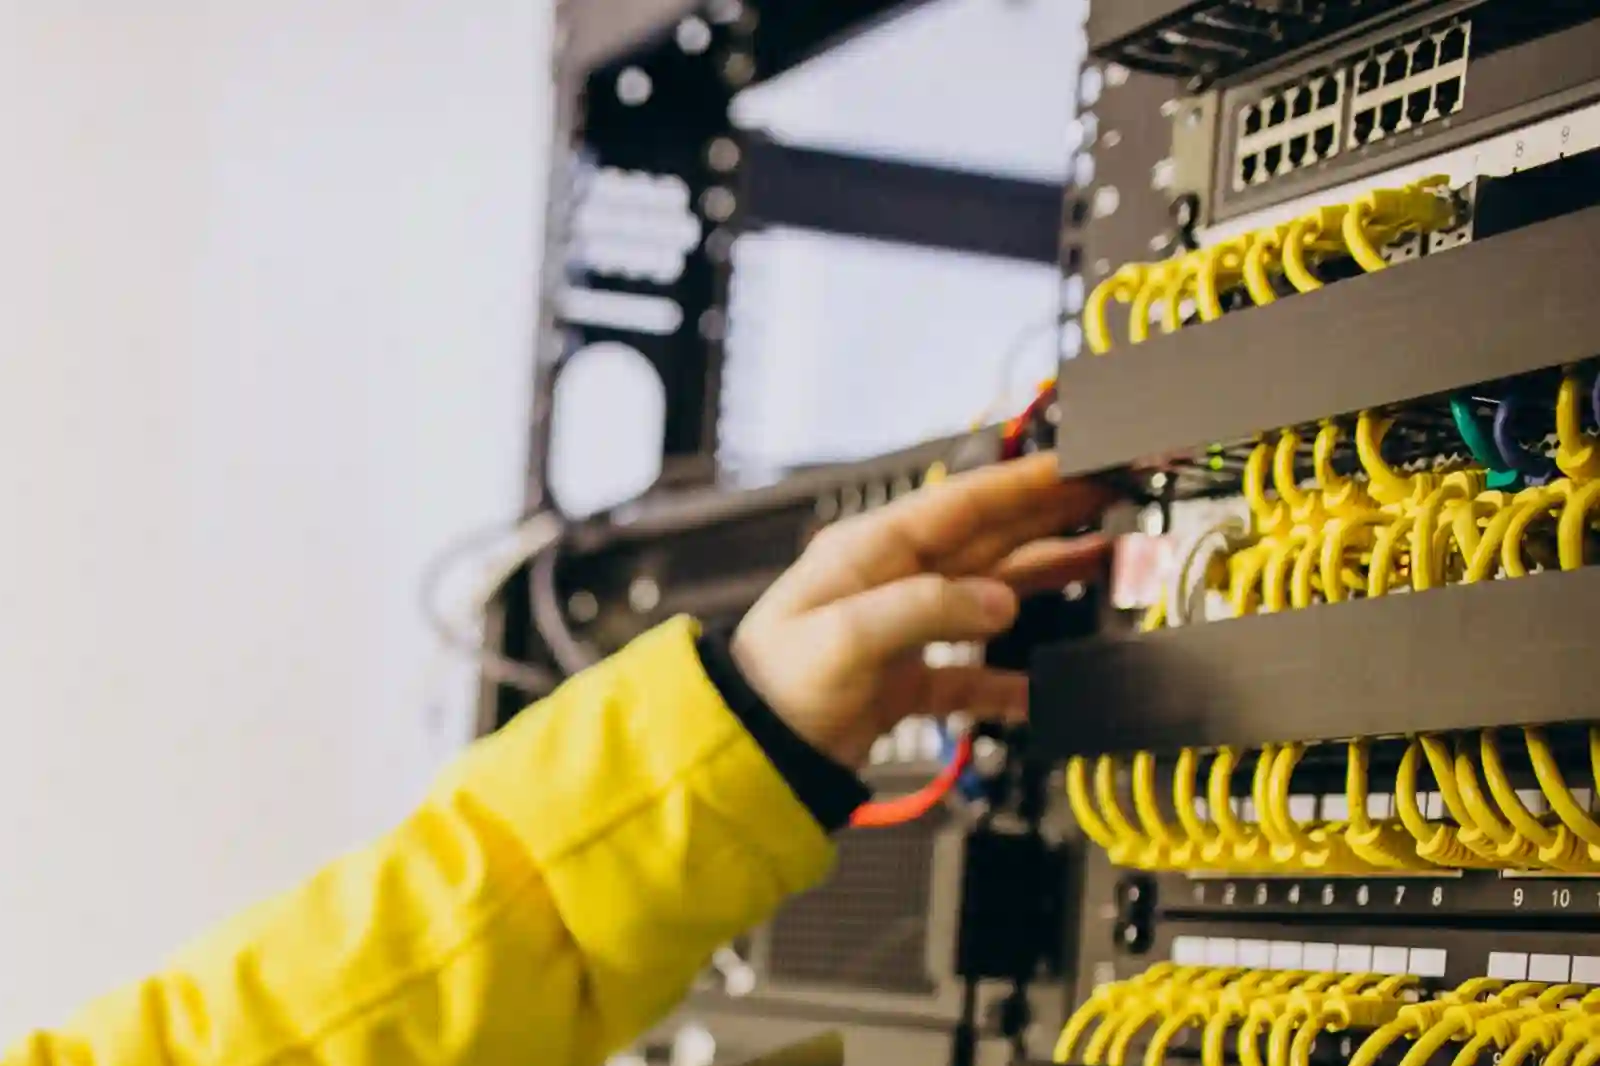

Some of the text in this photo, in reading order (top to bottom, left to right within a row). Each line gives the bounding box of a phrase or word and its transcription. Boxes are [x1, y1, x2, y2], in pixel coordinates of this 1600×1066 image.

[1515, 125, 1571, 157] 8 9
[1394, 885, 1406, 906] 7
[1431, 886, 1443, 907] 8
[1513, 887, 1524, 907] 9
[1551, 888, 1571, 908] 10
